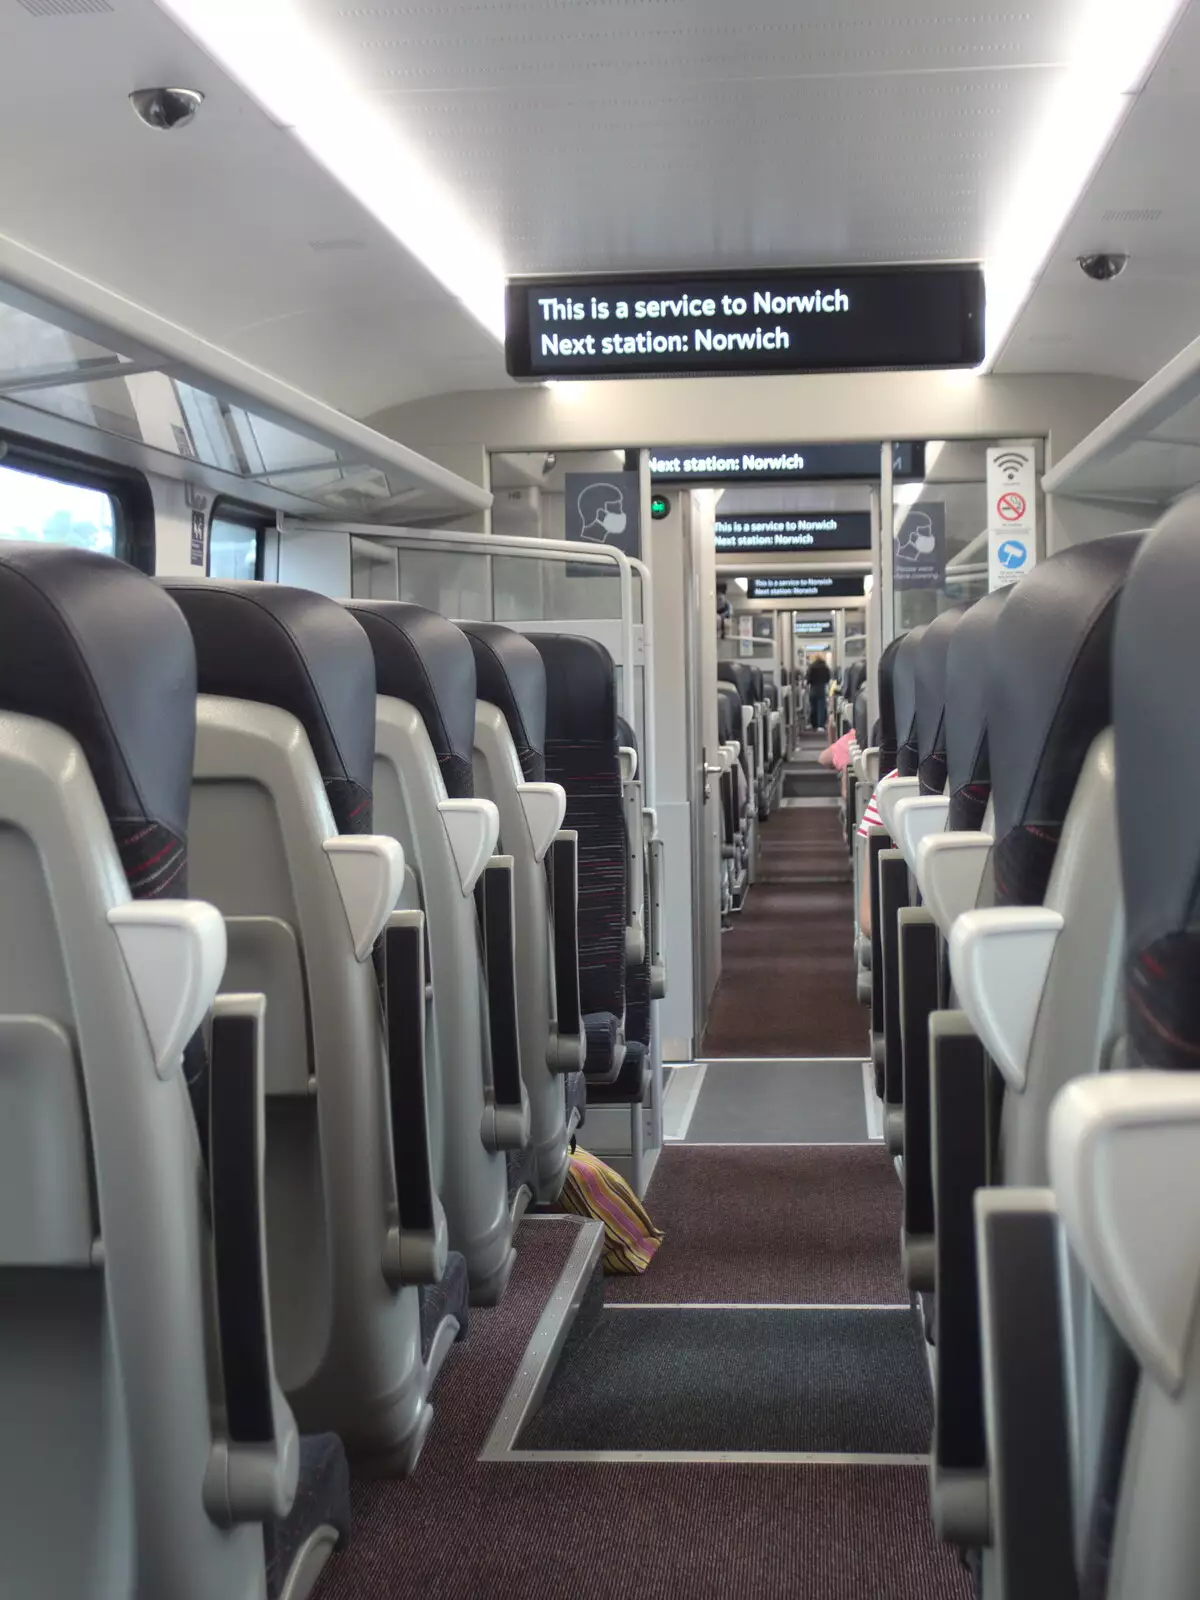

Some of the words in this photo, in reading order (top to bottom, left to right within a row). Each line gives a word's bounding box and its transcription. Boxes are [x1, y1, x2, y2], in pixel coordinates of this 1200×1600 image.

[538, 297, 585, 321] This
[591, 296, 609, 320] is
[615, 302, 628, 320] a
[635, 293, 715, 318] service
[721, 295, 747, 316] to
[753, 289, 848, 314] Norwich
[541, 330, 595, 356] Next
[601, 328, 688, 354] station:
[695, 326, 789, 351] Norwich
[684, 455, 739, 472] station:
[743, 453, 804, 471] Norwich
[733, 521, 742, 532] is
[743, 523, 750, 532] a
[751, 520, 784, 532] service
[786, 521, 796, 531] to
[798, 519, 837, 531] Norwich
[738, 535, 773, 546] station:
[775, 533, 813, 545] Norwich
[755, 578, 767, 587] This
[768, 578, 774, 587] is
[779, 578, 799, 587] service
[800, 578, 807, 586] to
[808, 577, 833, 586] Norwich
[754, 587, 769, 596] Next
[794, 586, 818, 595] Norwich
